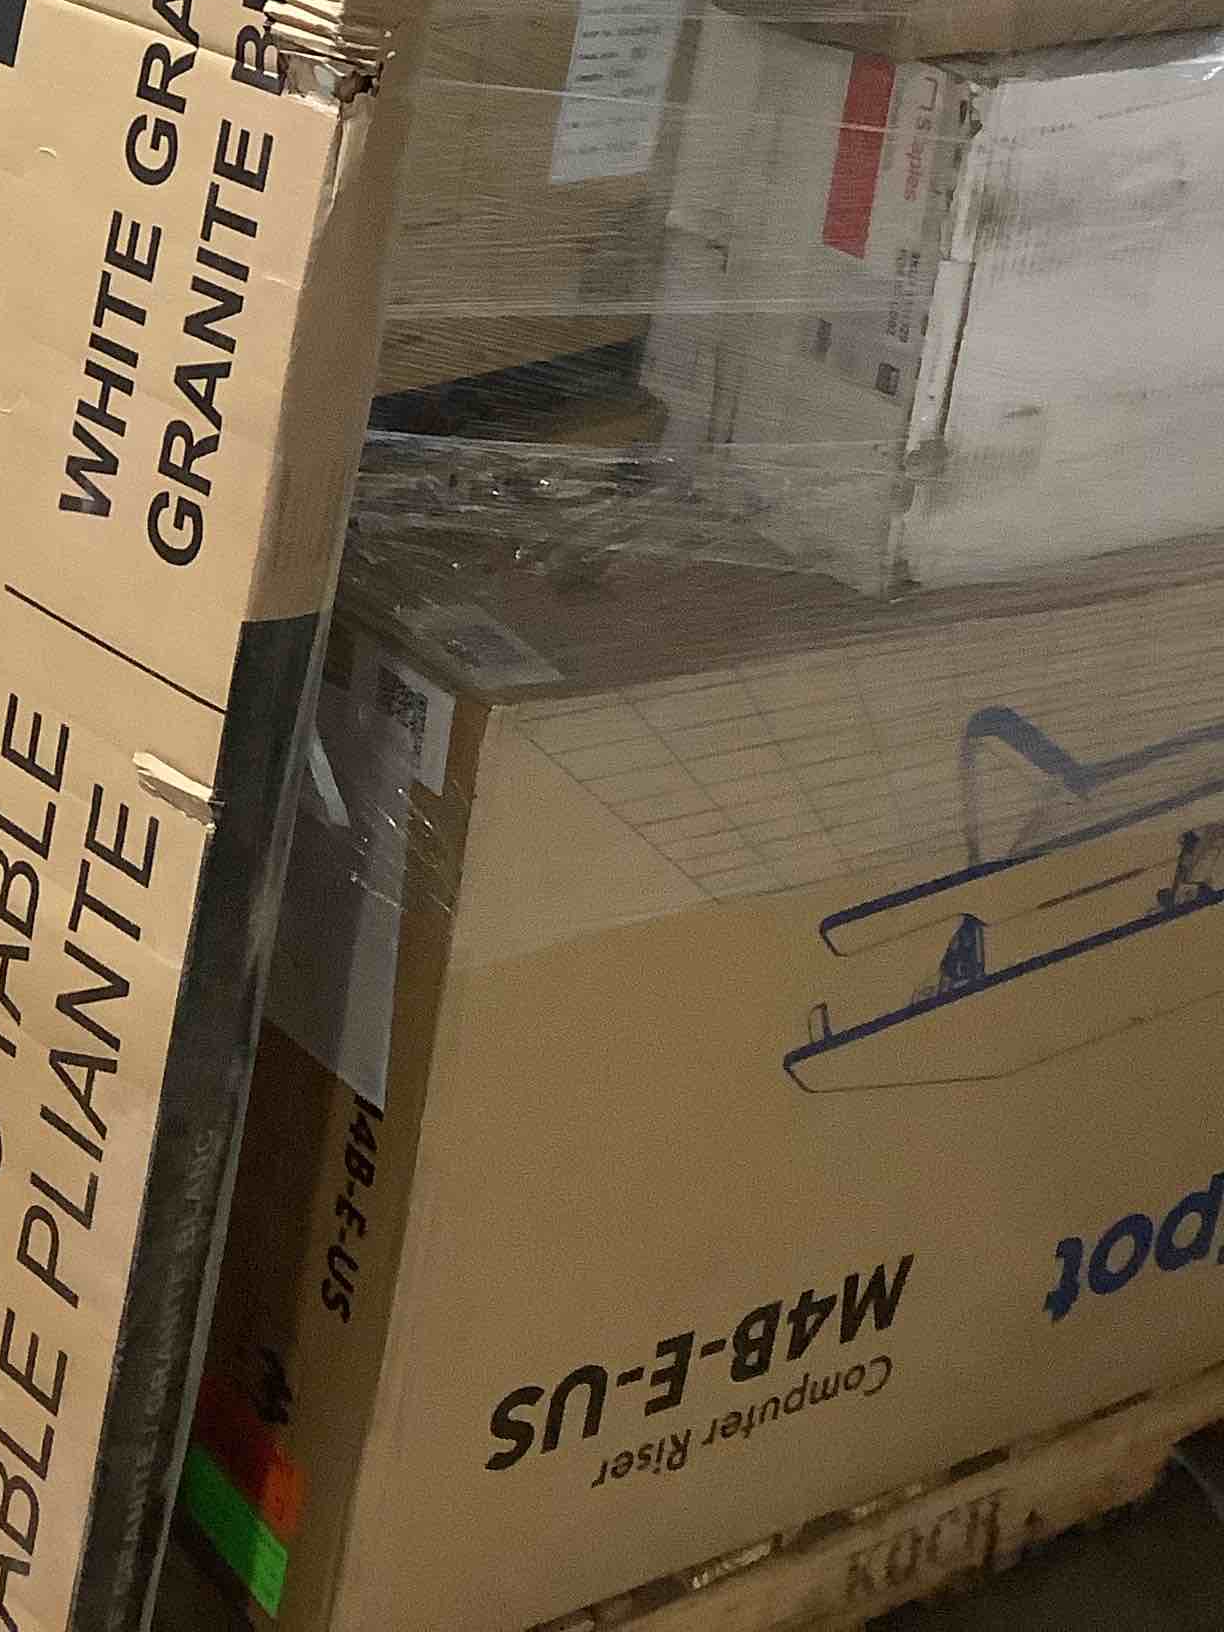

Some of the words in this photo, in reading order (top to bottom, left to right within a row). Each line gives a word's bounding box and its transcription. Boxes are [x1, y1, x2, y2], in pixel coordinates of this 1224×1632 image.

[58, 210, 162, 518] WHITE
[147, 119, 274, 567] GRANITE
[16, 784, 160, 1309] PLIANTE
[321, 1093, 385, 1323] 4B-E-US
[1041, 1171, 1224, 1324] pot
[484, 1252, 914, 1472] M4B-E-US
[589, 1425, 694, 1489] Riser
[701, 1354, 893, 1448] Computer
